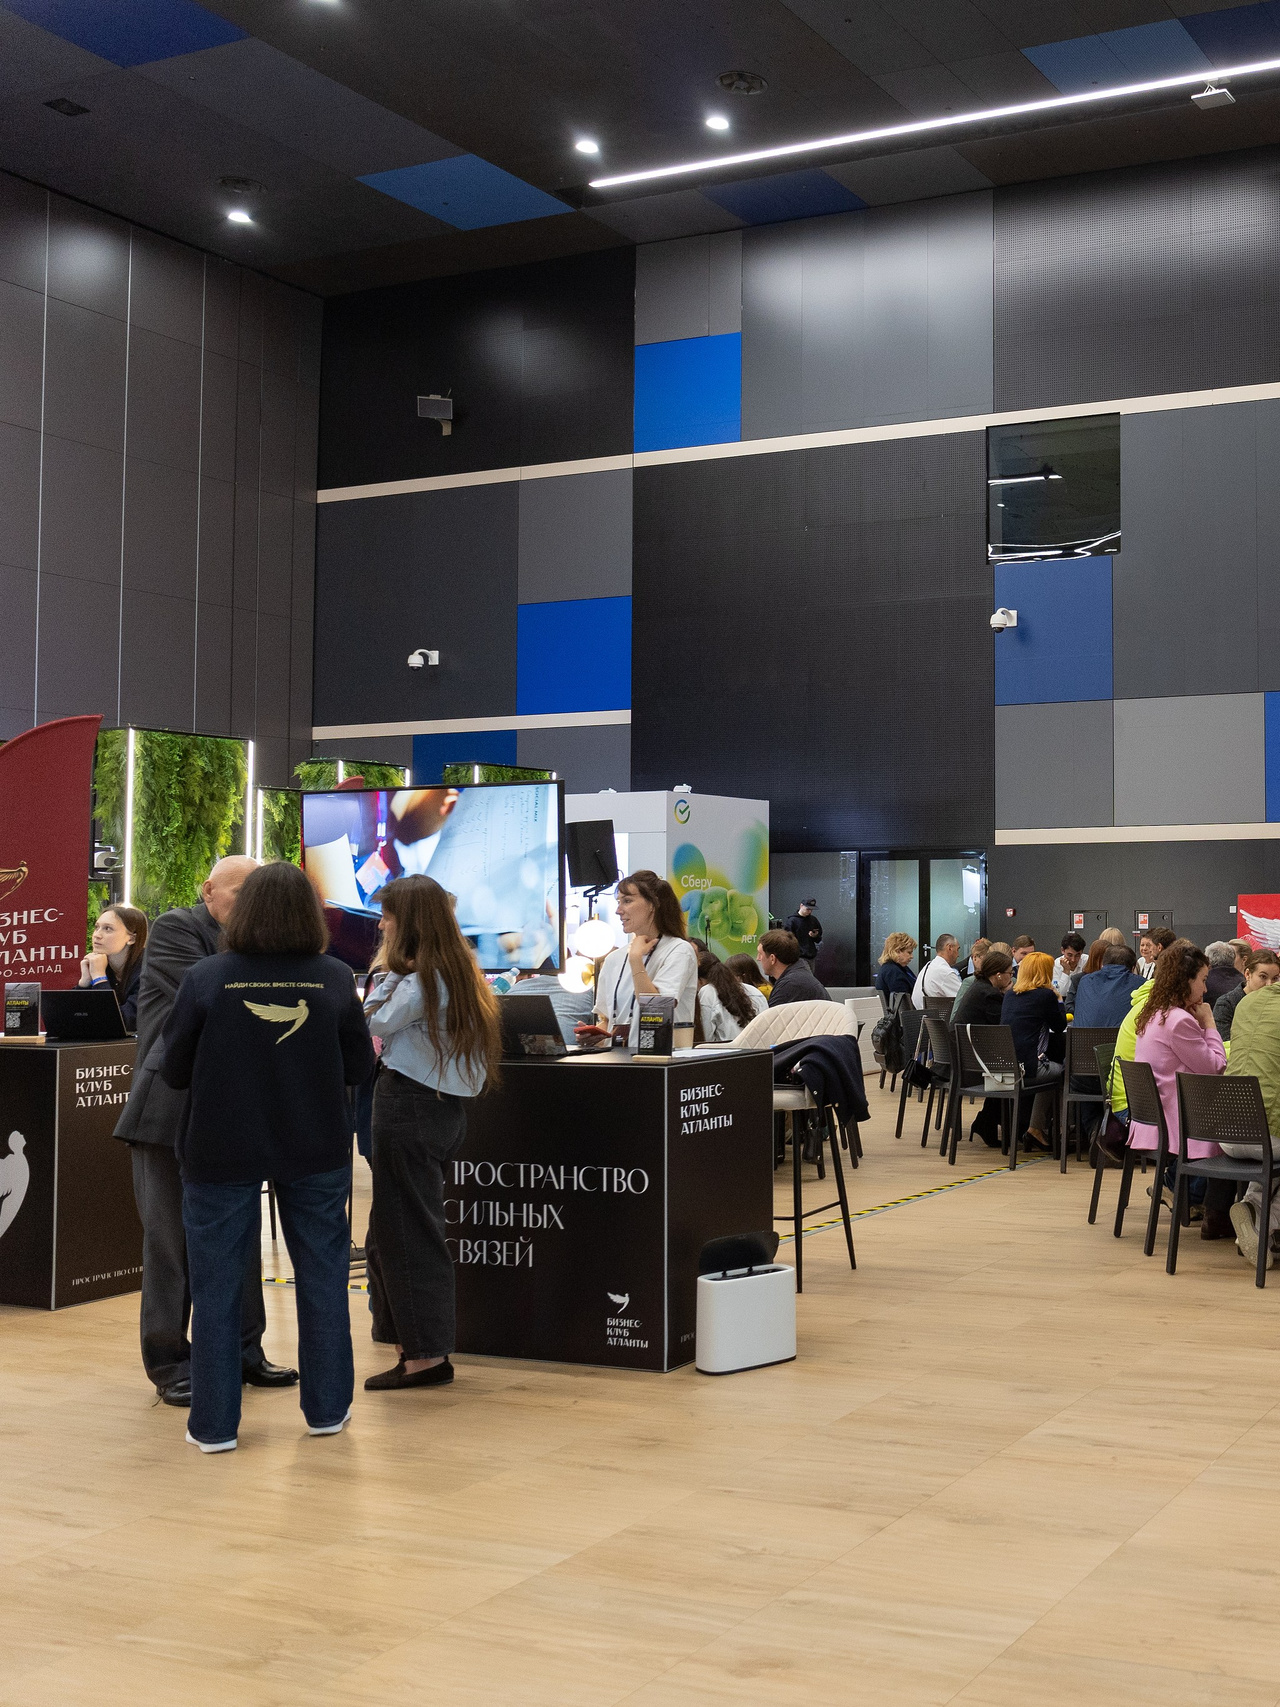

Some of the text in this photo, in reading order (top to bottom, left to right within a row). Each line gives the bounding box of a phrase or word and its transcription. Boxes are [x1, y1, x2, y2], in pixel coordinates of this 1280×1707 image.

[681, 874, 712, 890] Сберу
[741, 934, 757, 944] лет
[0, 964, 62, 978] О-ЗАПАД
[75, 1064, 134, 1080] БИЗНЕС-
[75, 1080, 112, 1094] КЛУБ
[680, 1083, 725, 1102] БИЗНЕС-
[75, 1091, 131, 1108] АТЛАНТ
[680, 1102, 709, 1119] КЛУБ
[680, 1114, 733, 1136] АТЛАНТЫ
[606, 1317, 643, 1328] БИЗНЕС-
[606, 1327, 630, 1337] КЛУБ
[606, 1337, 649, 1349] АТЛАНТЫ
